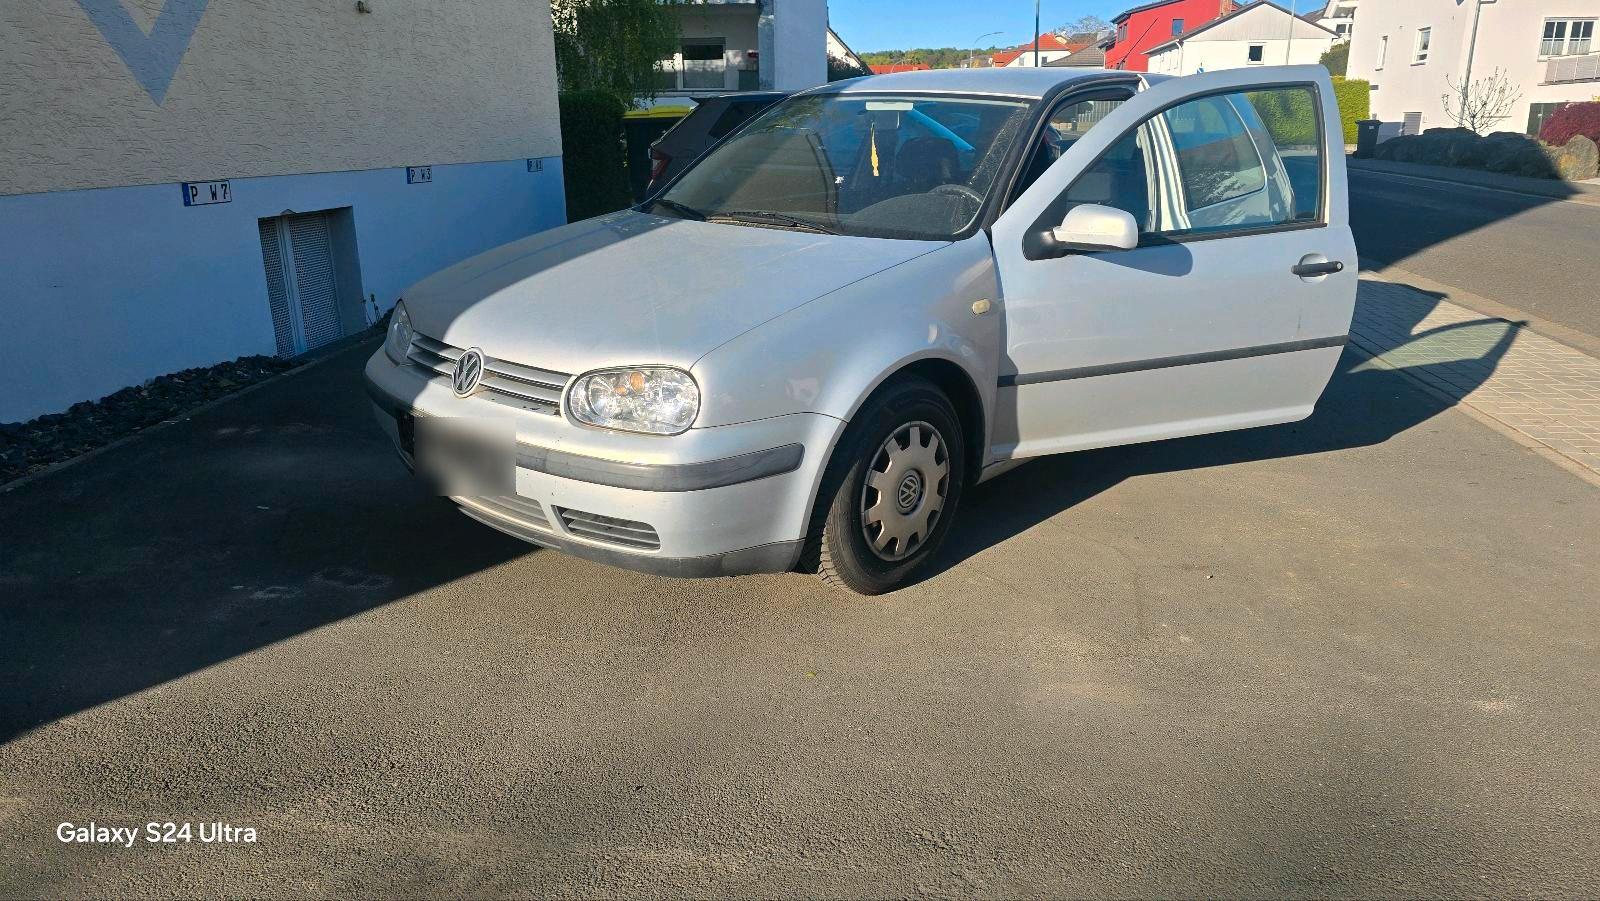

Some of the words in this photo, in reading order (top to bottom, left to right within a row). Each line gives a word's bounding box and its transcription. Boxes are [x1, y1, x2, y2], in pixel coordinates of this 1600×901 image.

[190, 185, 198, 203] P
[209, 183, 228, 201] W7
[453, 350, 482, 395] VW
